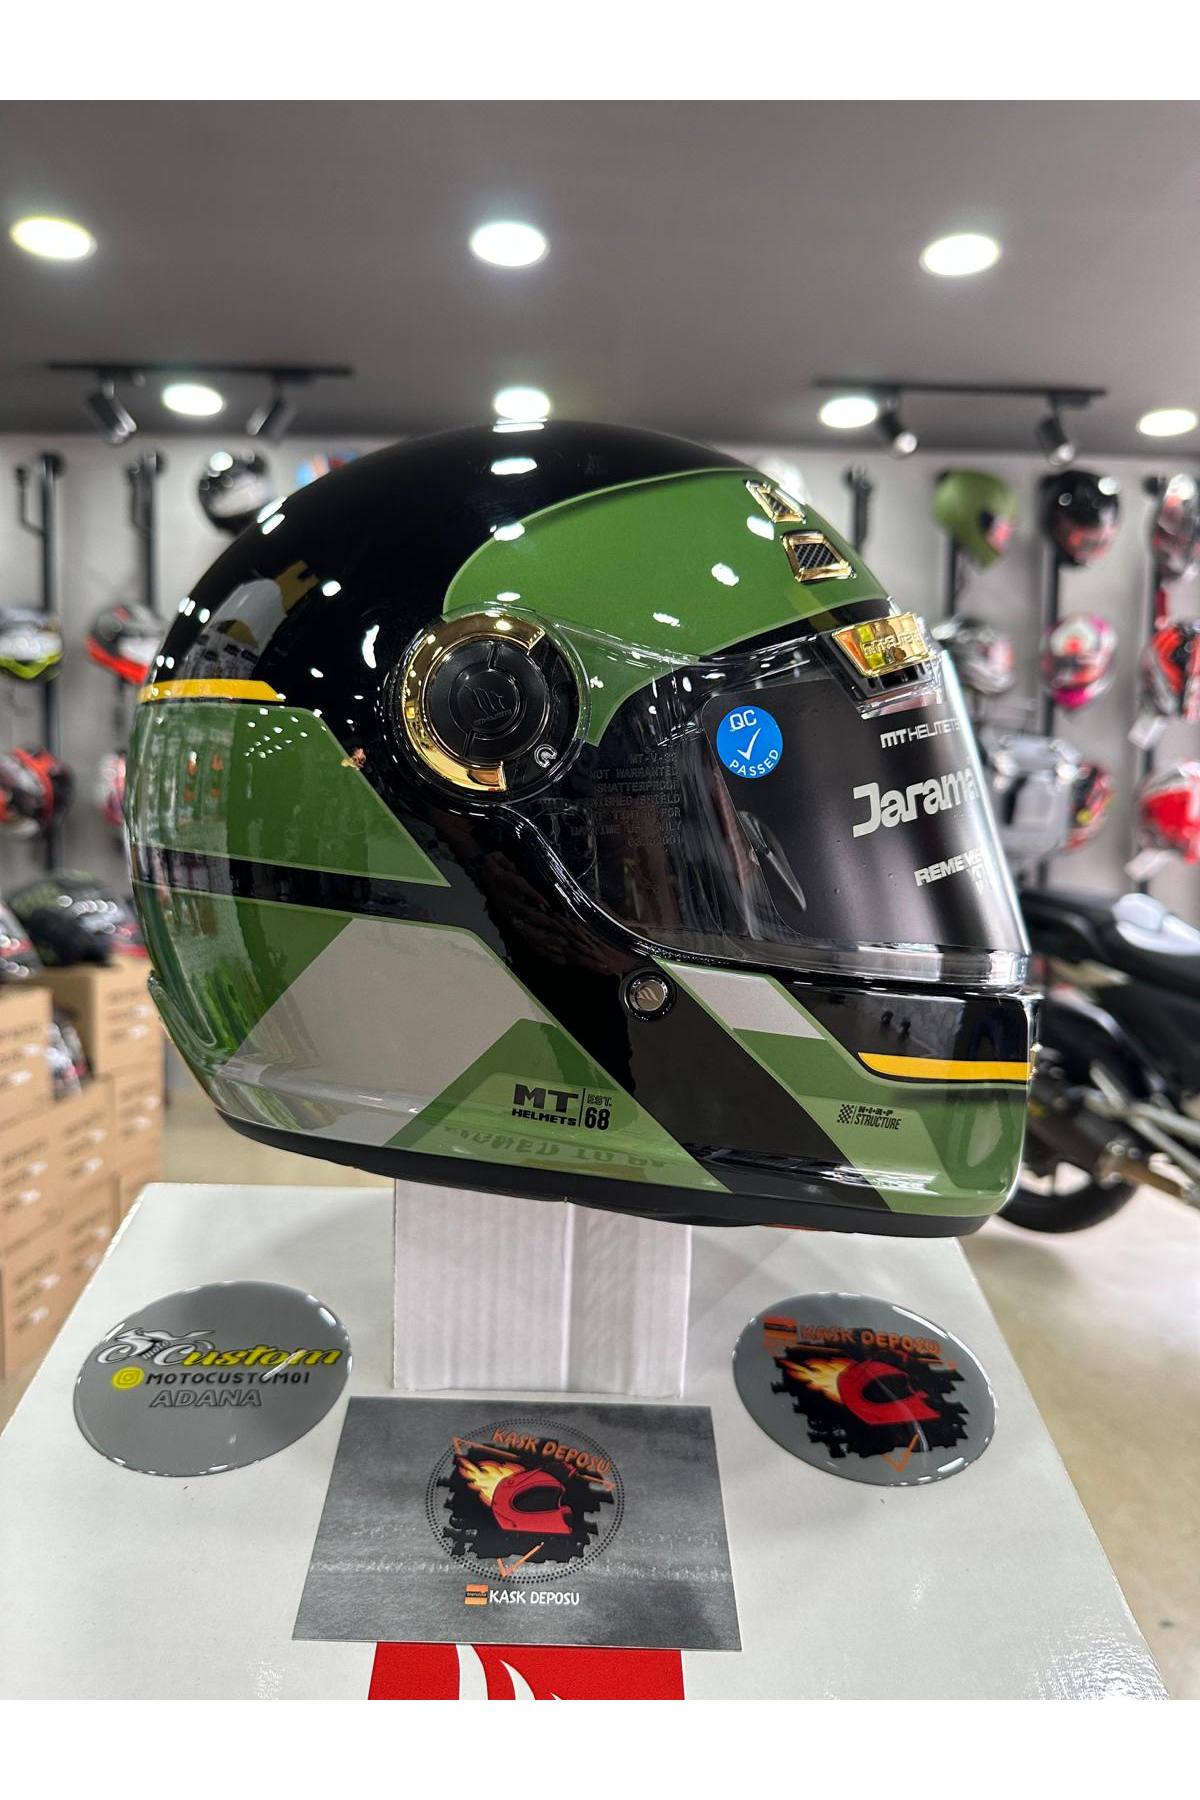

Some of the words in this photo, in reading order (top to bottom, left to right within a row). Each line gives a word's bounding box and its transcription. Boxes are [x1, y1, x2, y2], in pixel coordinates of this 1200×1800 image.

[729, 709, 757, 732] QC
[880, 729, 907, 748] MT
[729, 749, 779, 776] PASSED
[853, 768, 980, 838] Jarama
[514, 1084, 578, 1113] MT
[512, 1108, 577, 1127] HELMETS
[584, 1106, 610, 1131] 68
[854, 1113, 902, 1130] STRUCTURE
[153, 1338, 342, 1367] Custom
[149, 1388, 263, 1409] ADANA
[492, 1427, 540, 1454] KASK
[542, 1440, 614, 1477] DEPOSU
[489, 1589, 526, 1605] KASK
[530, 1591, 580, 1606] DEPOSU
